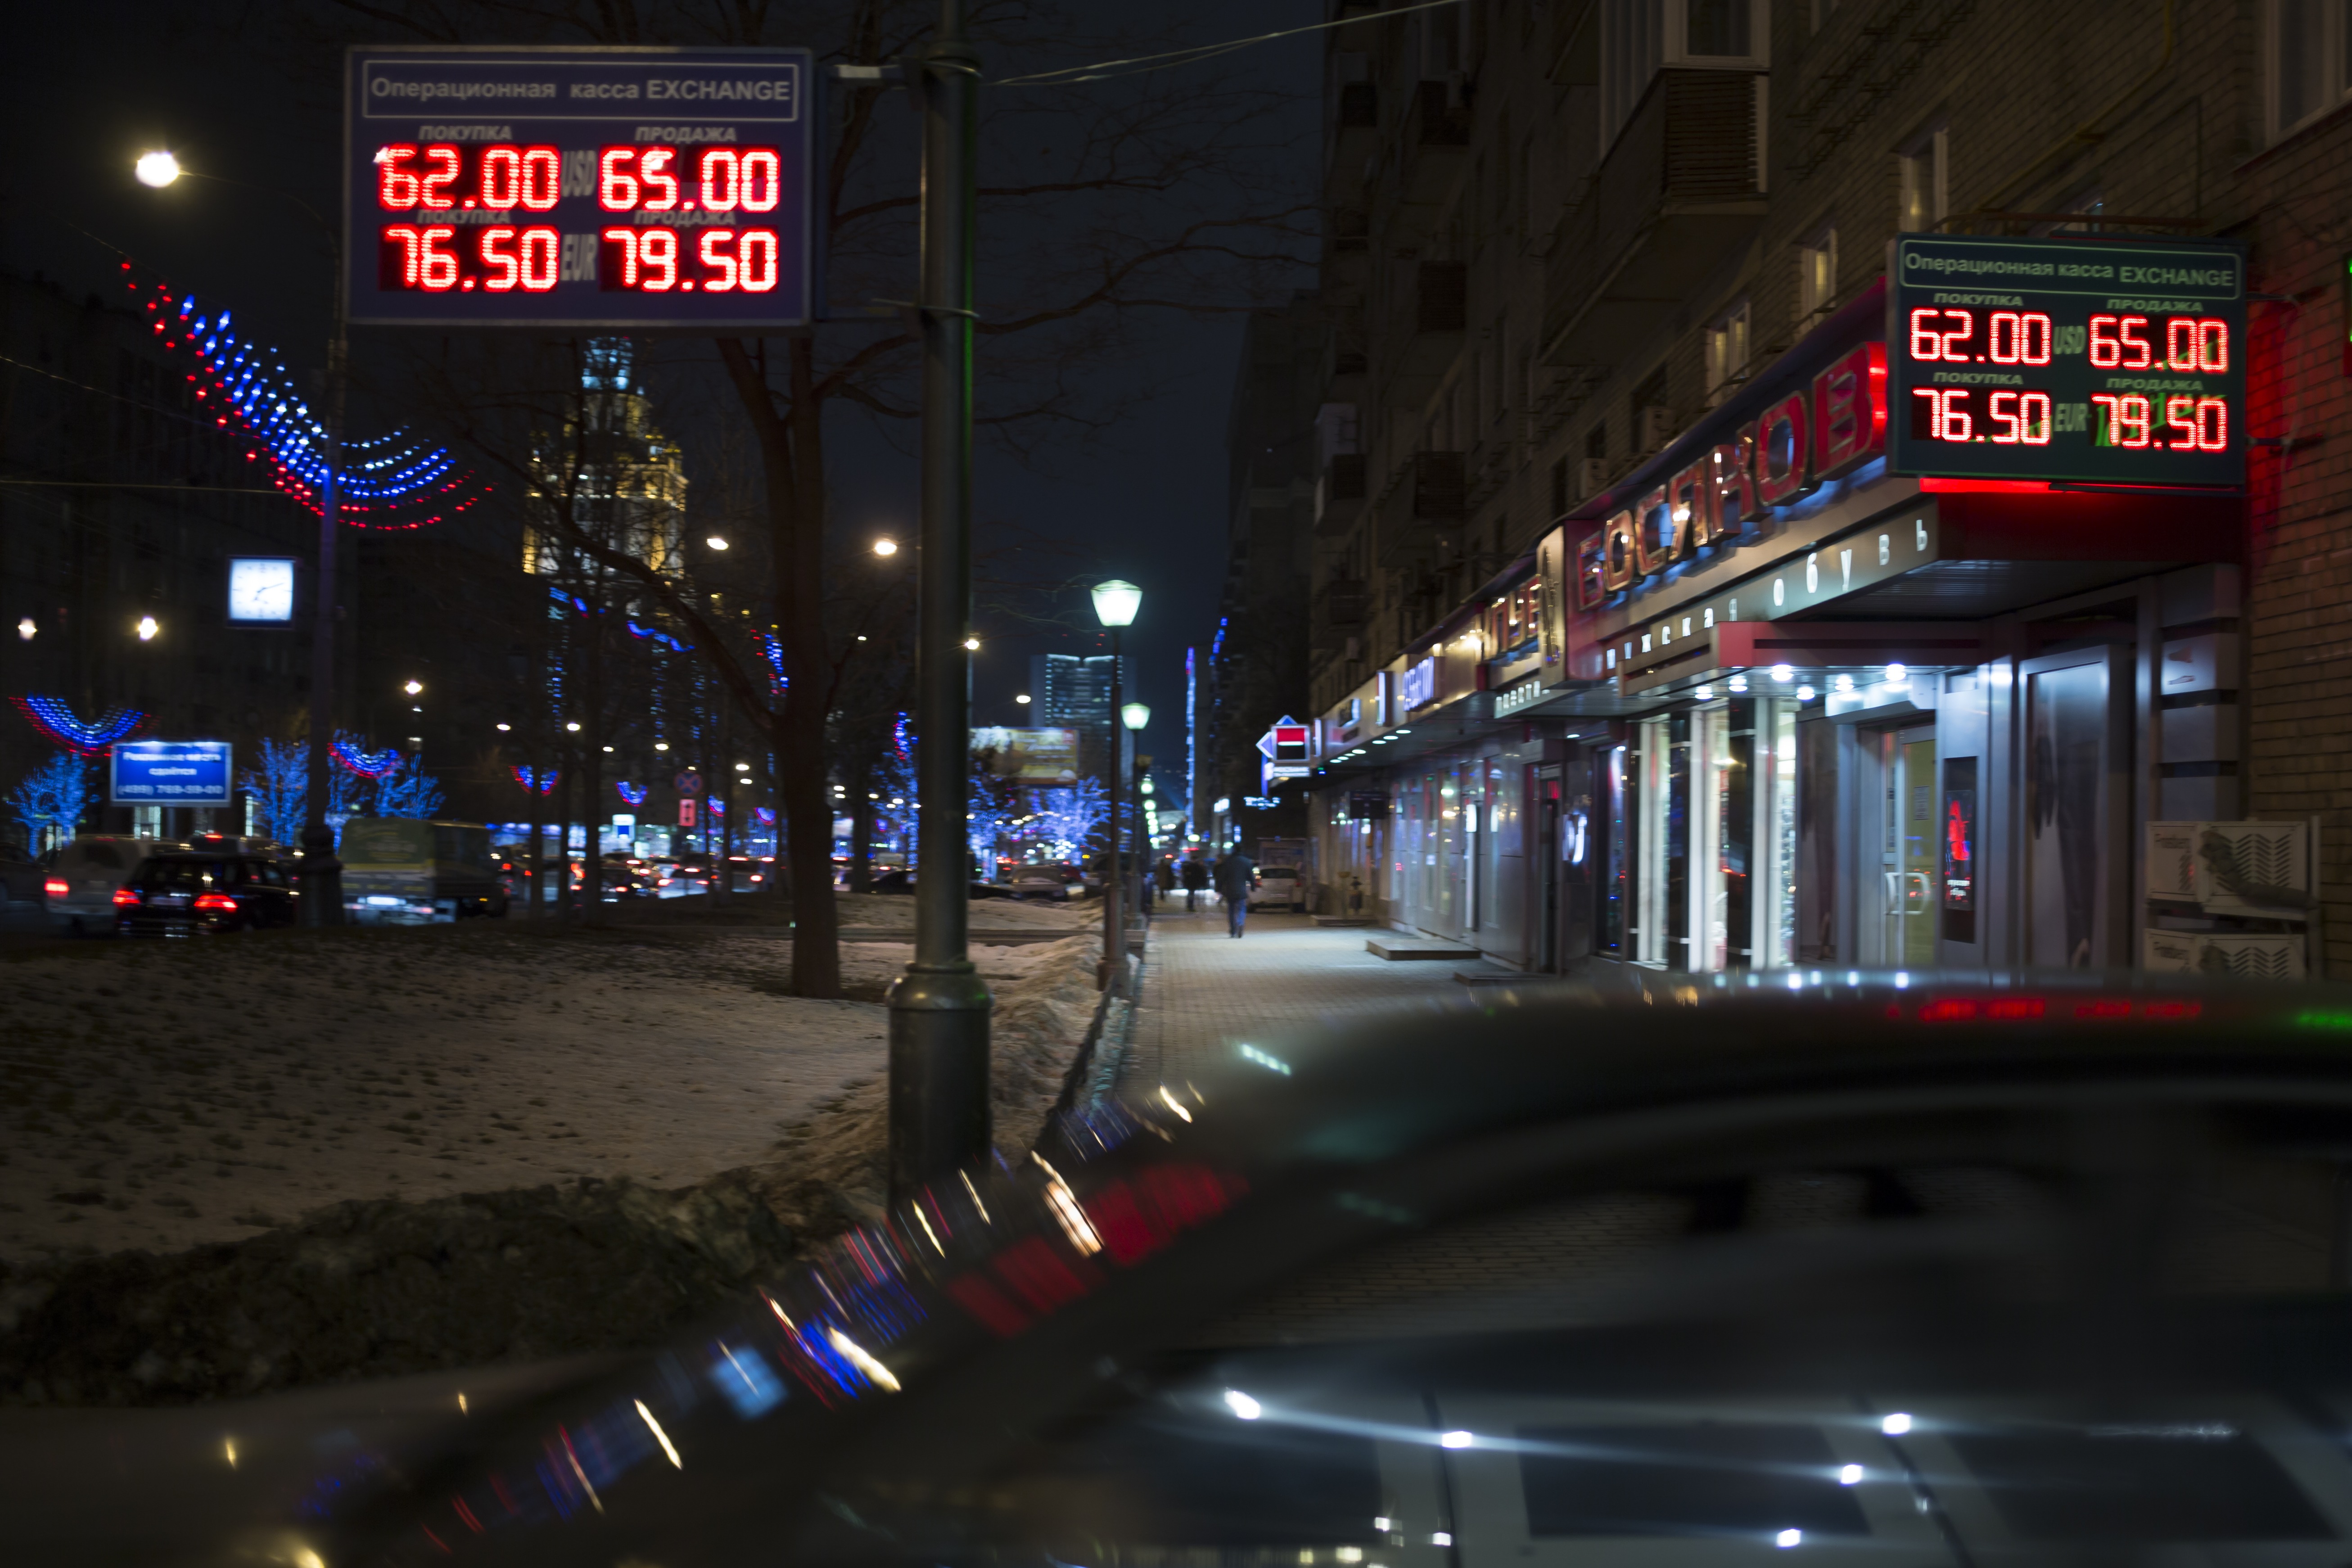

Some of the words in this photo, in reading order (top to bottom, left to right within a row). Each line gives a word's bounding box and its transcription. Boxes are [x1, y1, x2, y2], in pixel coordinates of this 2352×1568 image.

[371, 77, 556, 100] Операционная
[570, 81, 639, 99] касса
[646, 80, 790, 100] EXCHANGE
[419, 125, 512, 140] ПОКУПКА
[635, 127, 736, 144] ПРОДАЖА
[381, 146, 559, 210] 62.00
[561, 150, 597, 197] USD
[600, 147, 780, 212] 65.00
[417, 208, 511, 224] ПОКУПКА
[634, 209, 736, 227] ПРОДАЖА
[384, 225, 559, 291] 76.50
[560, 234, 599, 280] EUR
[602, 226, 779, 292] 79.50
[1905, 253, 2054, 276] Операционная
[2058, 262, 2114, 278] касса
[2120, 267, 2235, 286] EXCHANGE
[1933, 293, 2024, 307] ПОКУПКА
[2107, 298, 2204, 312] ПРОДАЖА
[1910, 307, 2051, 366] 62.00
[2054, 325, 2086, 355] USD
[2089, 314, 2229, 373] 65.00
[1933, 372, 2024, 385] ПОКУПКА
[2106, 378, 2203, 392] ПРОДАЖА
[1912, 388, 2051, 445] 76.50
[2055, 403, 2088, 432] EUR
[2090, 393, 2228, 452] 79.50
[1773, 519, 1928, 606] обувь
